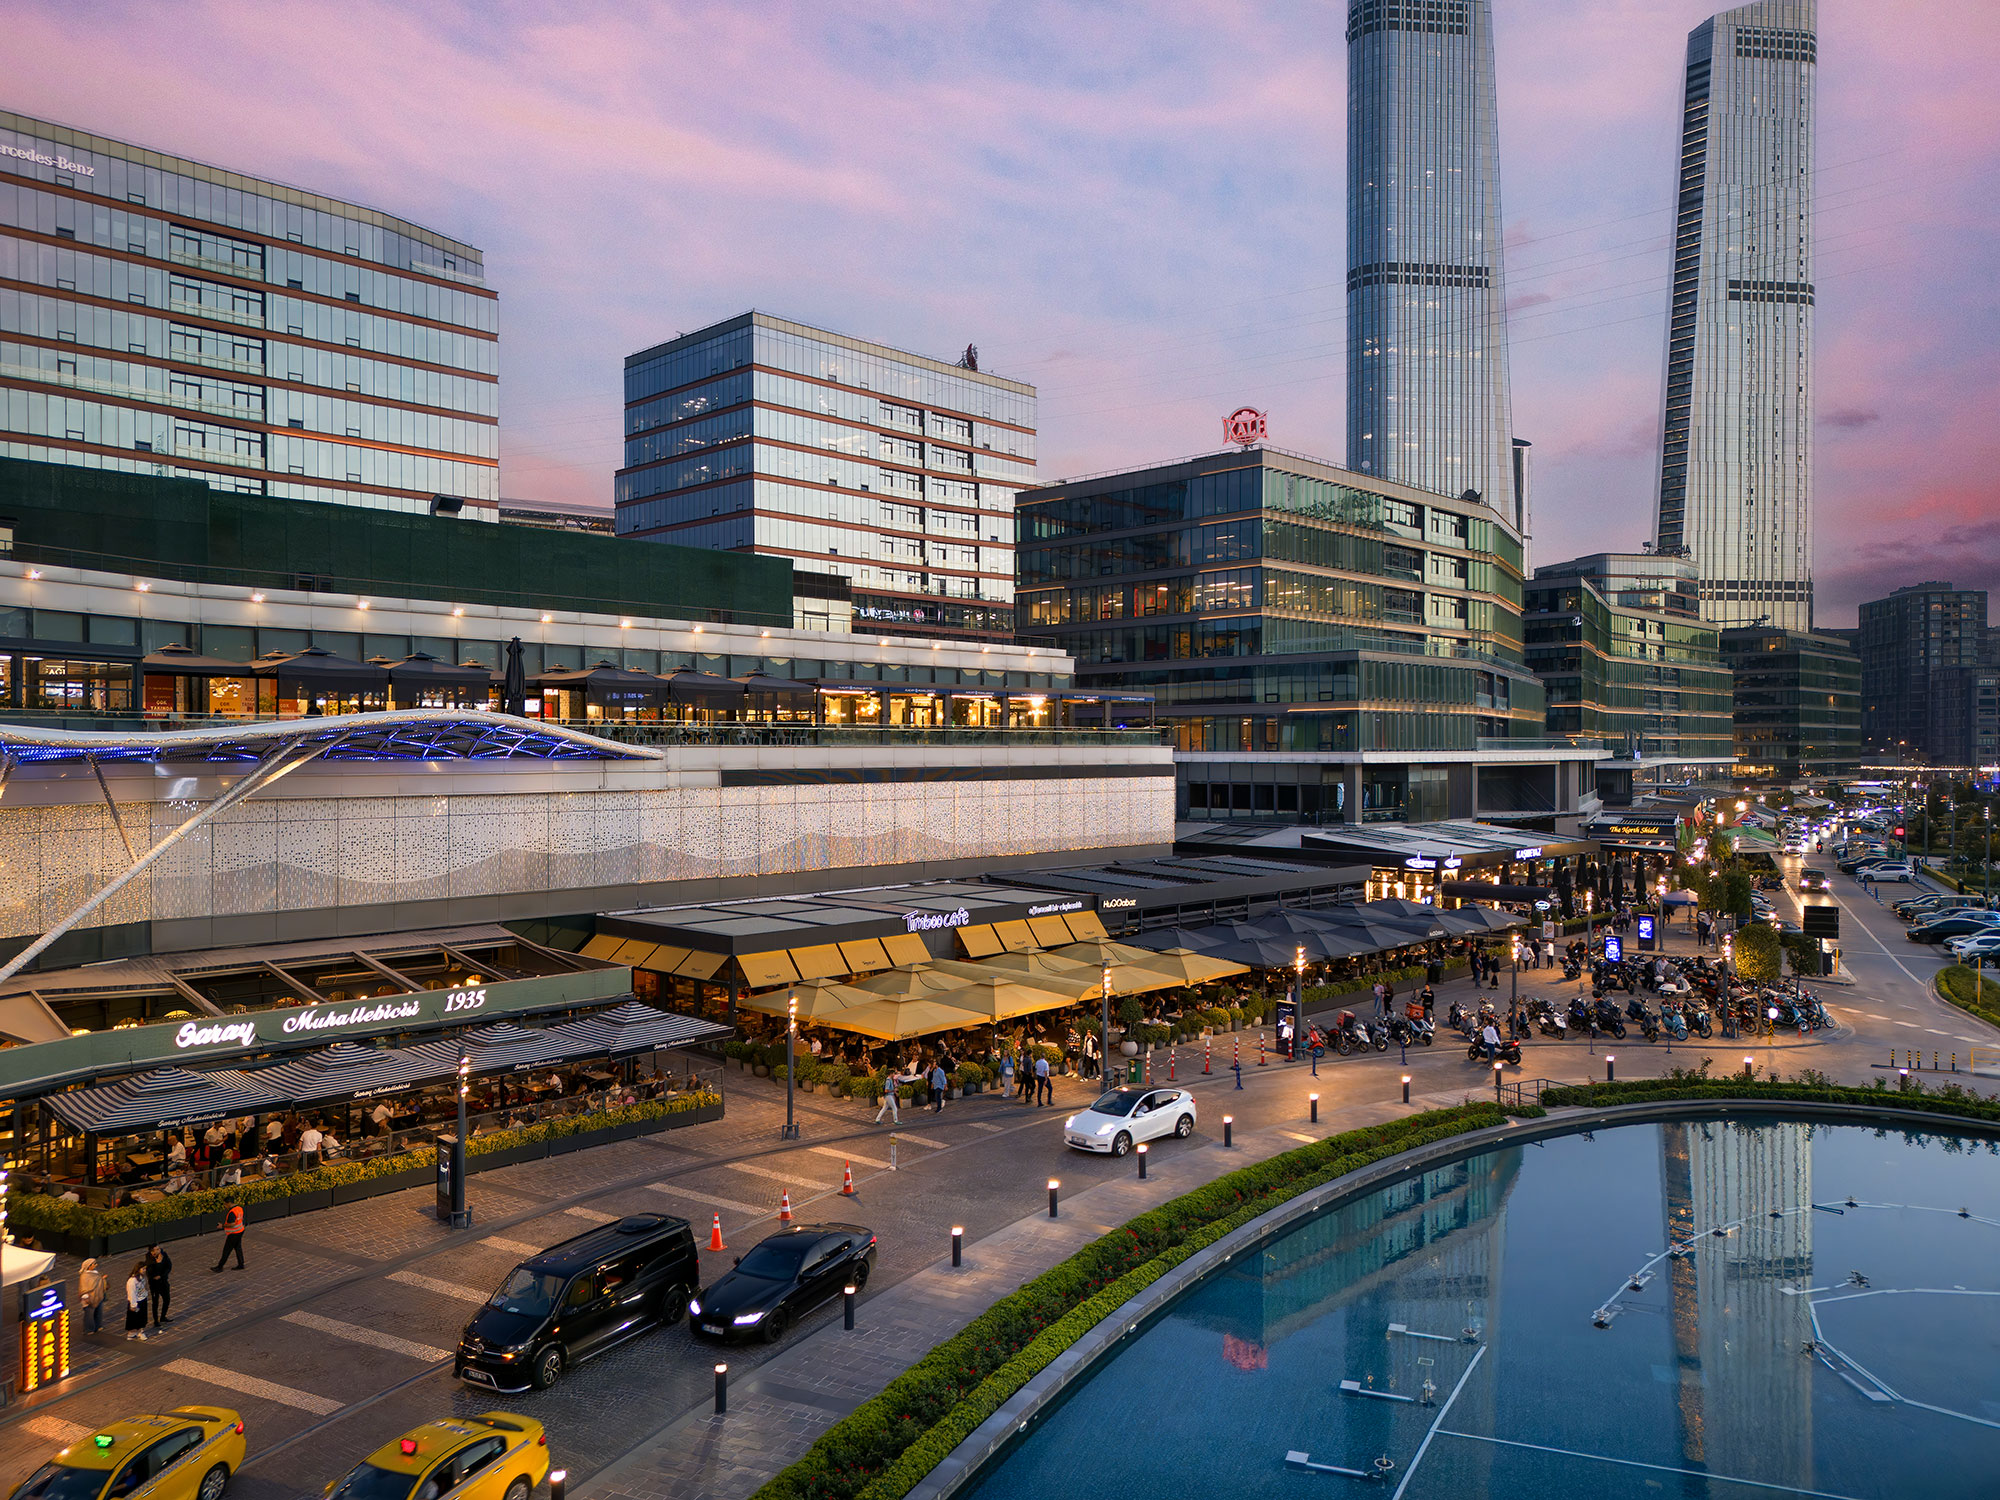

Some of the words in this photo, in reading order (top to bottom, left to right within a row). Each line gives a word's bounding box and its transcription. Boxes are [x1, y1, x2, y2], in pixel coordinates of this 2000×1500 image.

[0, 144, 95, 177] rcedes-Benz
[1225, 418, 1267, 442] KALE
[1621, 826, 1640, 834] North
[1640, 826, 1660, 834] Shield
[902, 909, 943, 932] Timboo
[943, 906, 970, 927] cafe
[174, 1020, 256, 1048] Saray
[282, 1000, 421, 1034] Muhallebicisi
[444, 989, 487, 1012] 1935
